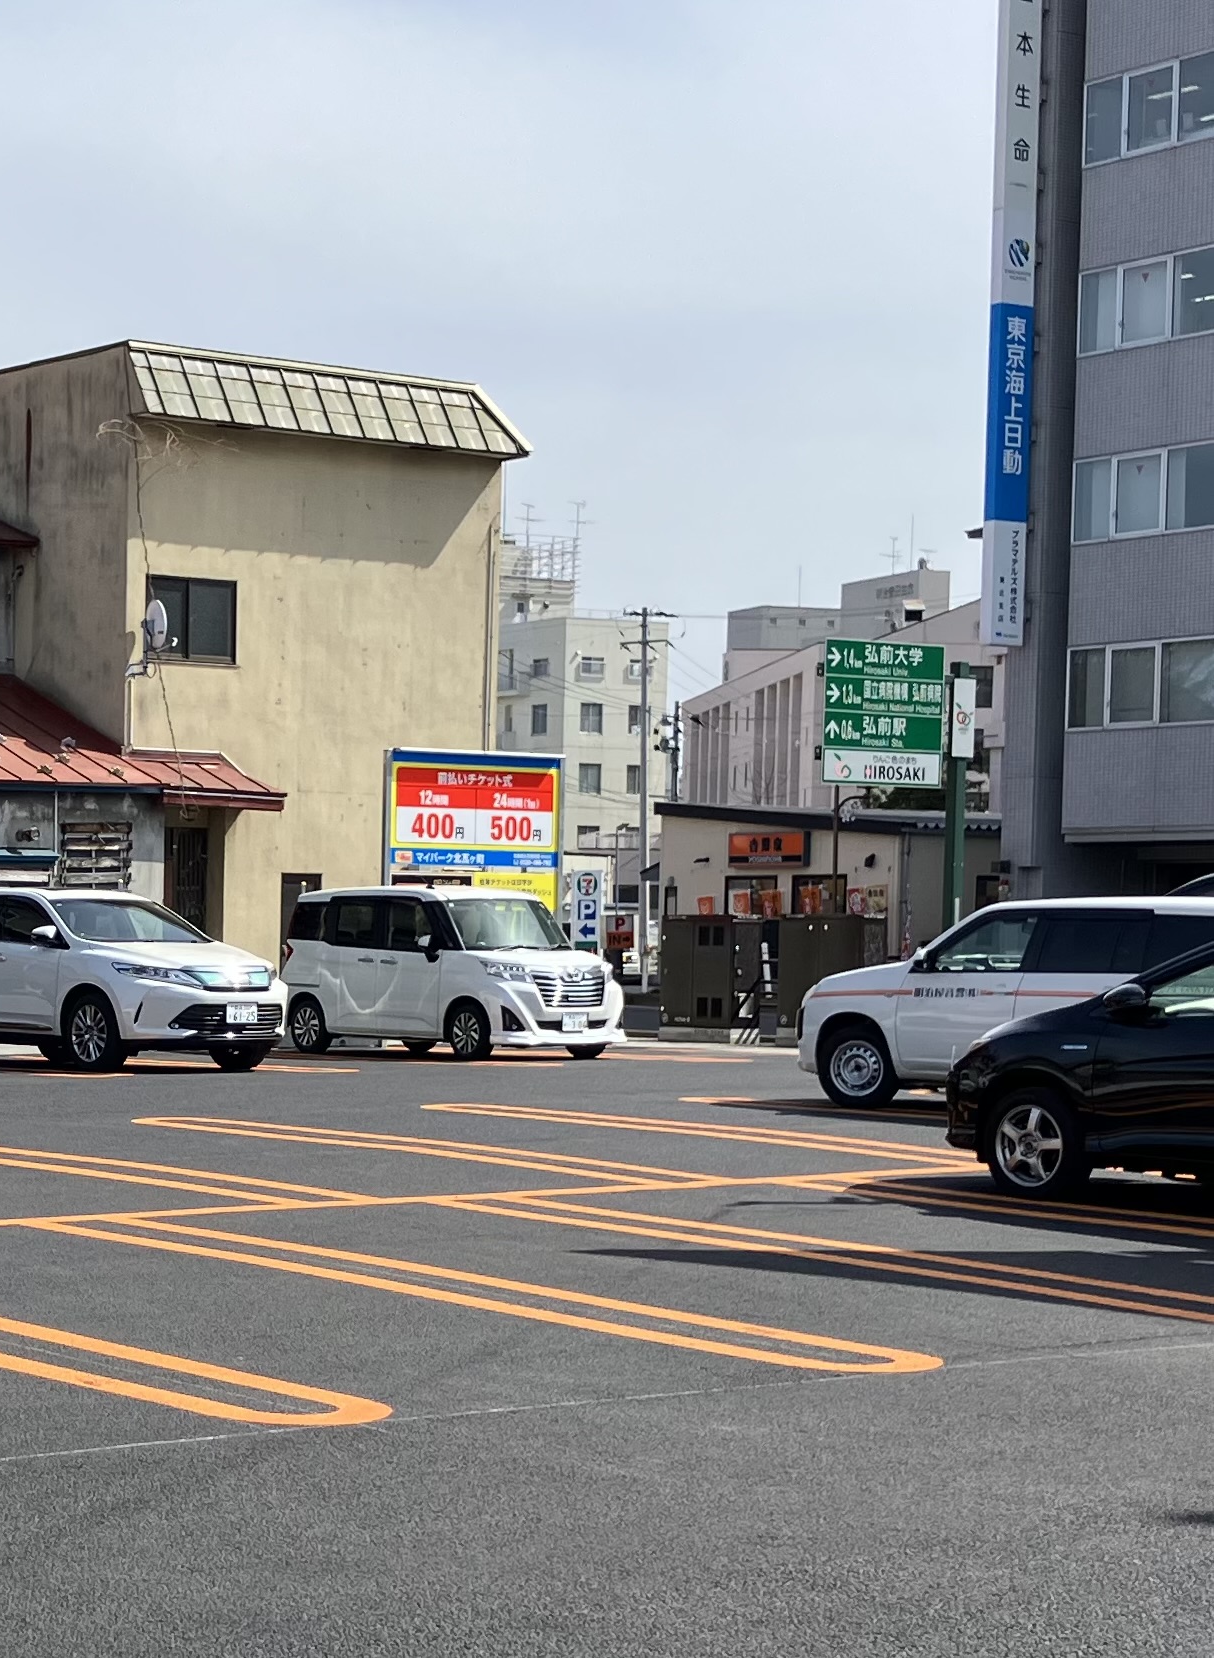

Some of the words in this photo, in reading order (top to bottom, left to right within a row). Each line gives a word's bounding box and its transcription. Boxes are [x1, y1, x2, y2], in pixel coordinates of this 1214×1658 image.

[1013, 0, 1034, 162] 本生命
[1002, 316, 1027, 476] 東京海上日動
[865, 645, 923, 666] 弘前大学
[863, 666, 892, 676] Hirosaki
[892, 668, 910, 677] Univ.
[863, 701, 888, 711] Hirosaki
[889, 703, 914, 713] National
[915, 704, 941, 715] Hospital
[863, 716, 906, 736] 弘前駅
[861, 737, 890, 747] Hirosaki
[437, 771, 513, 787] 前払いチケット式
[863, 765, 925, 781] HIROSAKI
[419, 789, 449, 806] 12時間
[411, 813, 465, 839] 400円
[490, 815, 542, 841] 500円
[580, 901, 595, 920] P
[615, 917, 626, 931] P
[608, 935, 621, 946] IN
[233, 1011, 256, 1021] 61-25
